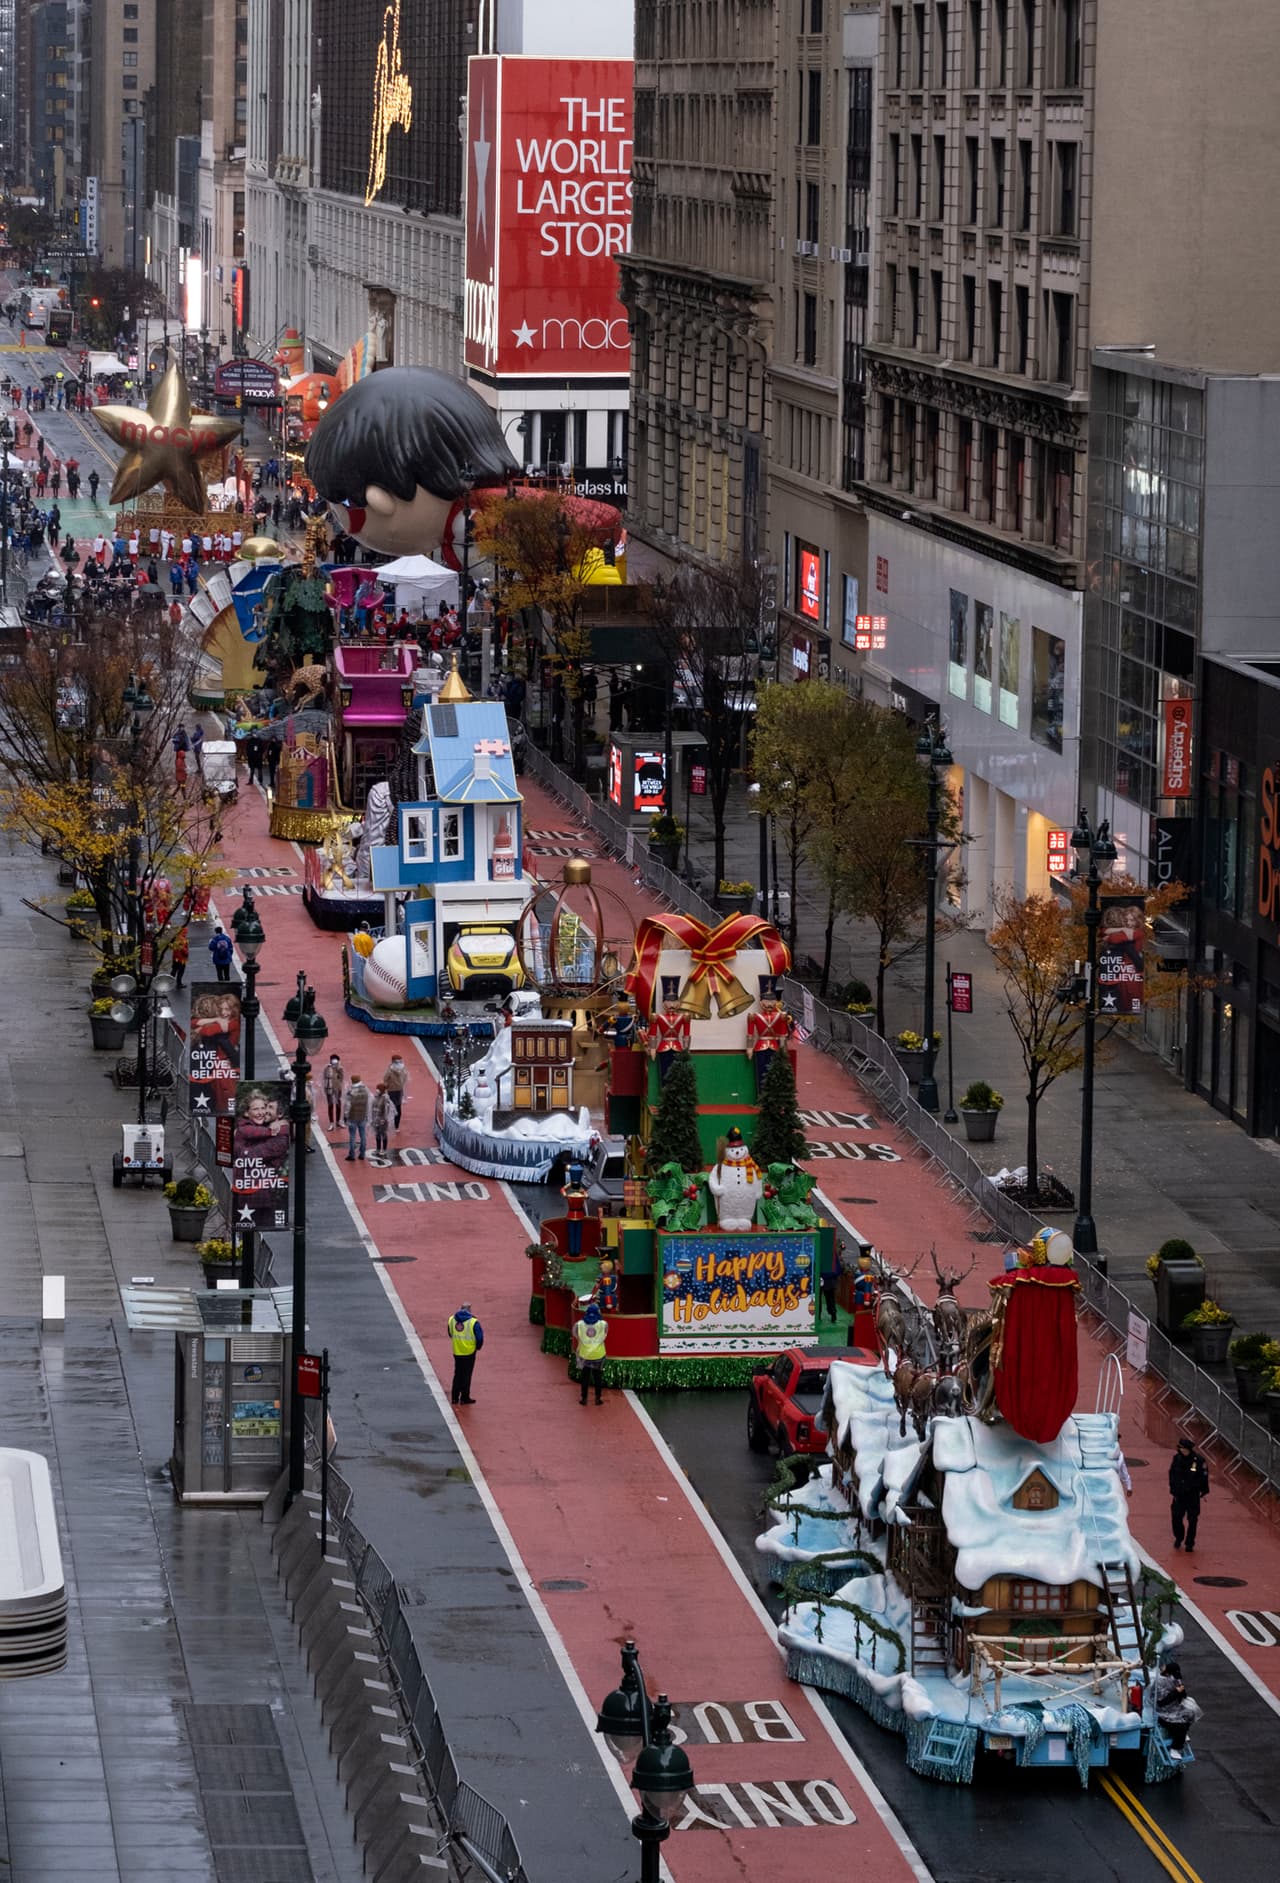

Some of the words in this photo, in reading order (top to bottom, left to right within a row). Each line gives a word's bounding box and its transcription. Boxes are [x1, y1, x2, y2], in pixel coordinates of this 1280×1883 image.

[560, 97, 626, 132] THE
[540, 222, 632, 257] STOR
[1168, 720, 1188, 788] Superdry
[523, 830, 589, 841] NLY
[1049, 863, 1064, 871] QLO
[1100, 956, 1125, 965] GIVE.
[1107, 965, 1136, 973] LOVE.
[1100, 973, 1144, 982] BELIEVE.
[191, 1050, 220, 1060] GIVE.
[200, 1060, 231, 1069] LOVE.
[191, 1069, 240, 1079] BELIEVE.
[795, 1109, 873, 1130] NLY
[804, 1141, 902, 1162] BUS
[235, 1157, 266, 1168] GIVE.
[244, 1168, 279, 1178] LOVE.
[235, 1179, 288, 1190] BELIEVE.
[375, 1181, 491, 1203] ONLY
[696, 1251, 786, 1283] Happy
[673, 1277, 810, 1323] Holidays!
[191, 1338, 199, 1378] Newsstand
[675, 1780, 858, 1831] ONLY
